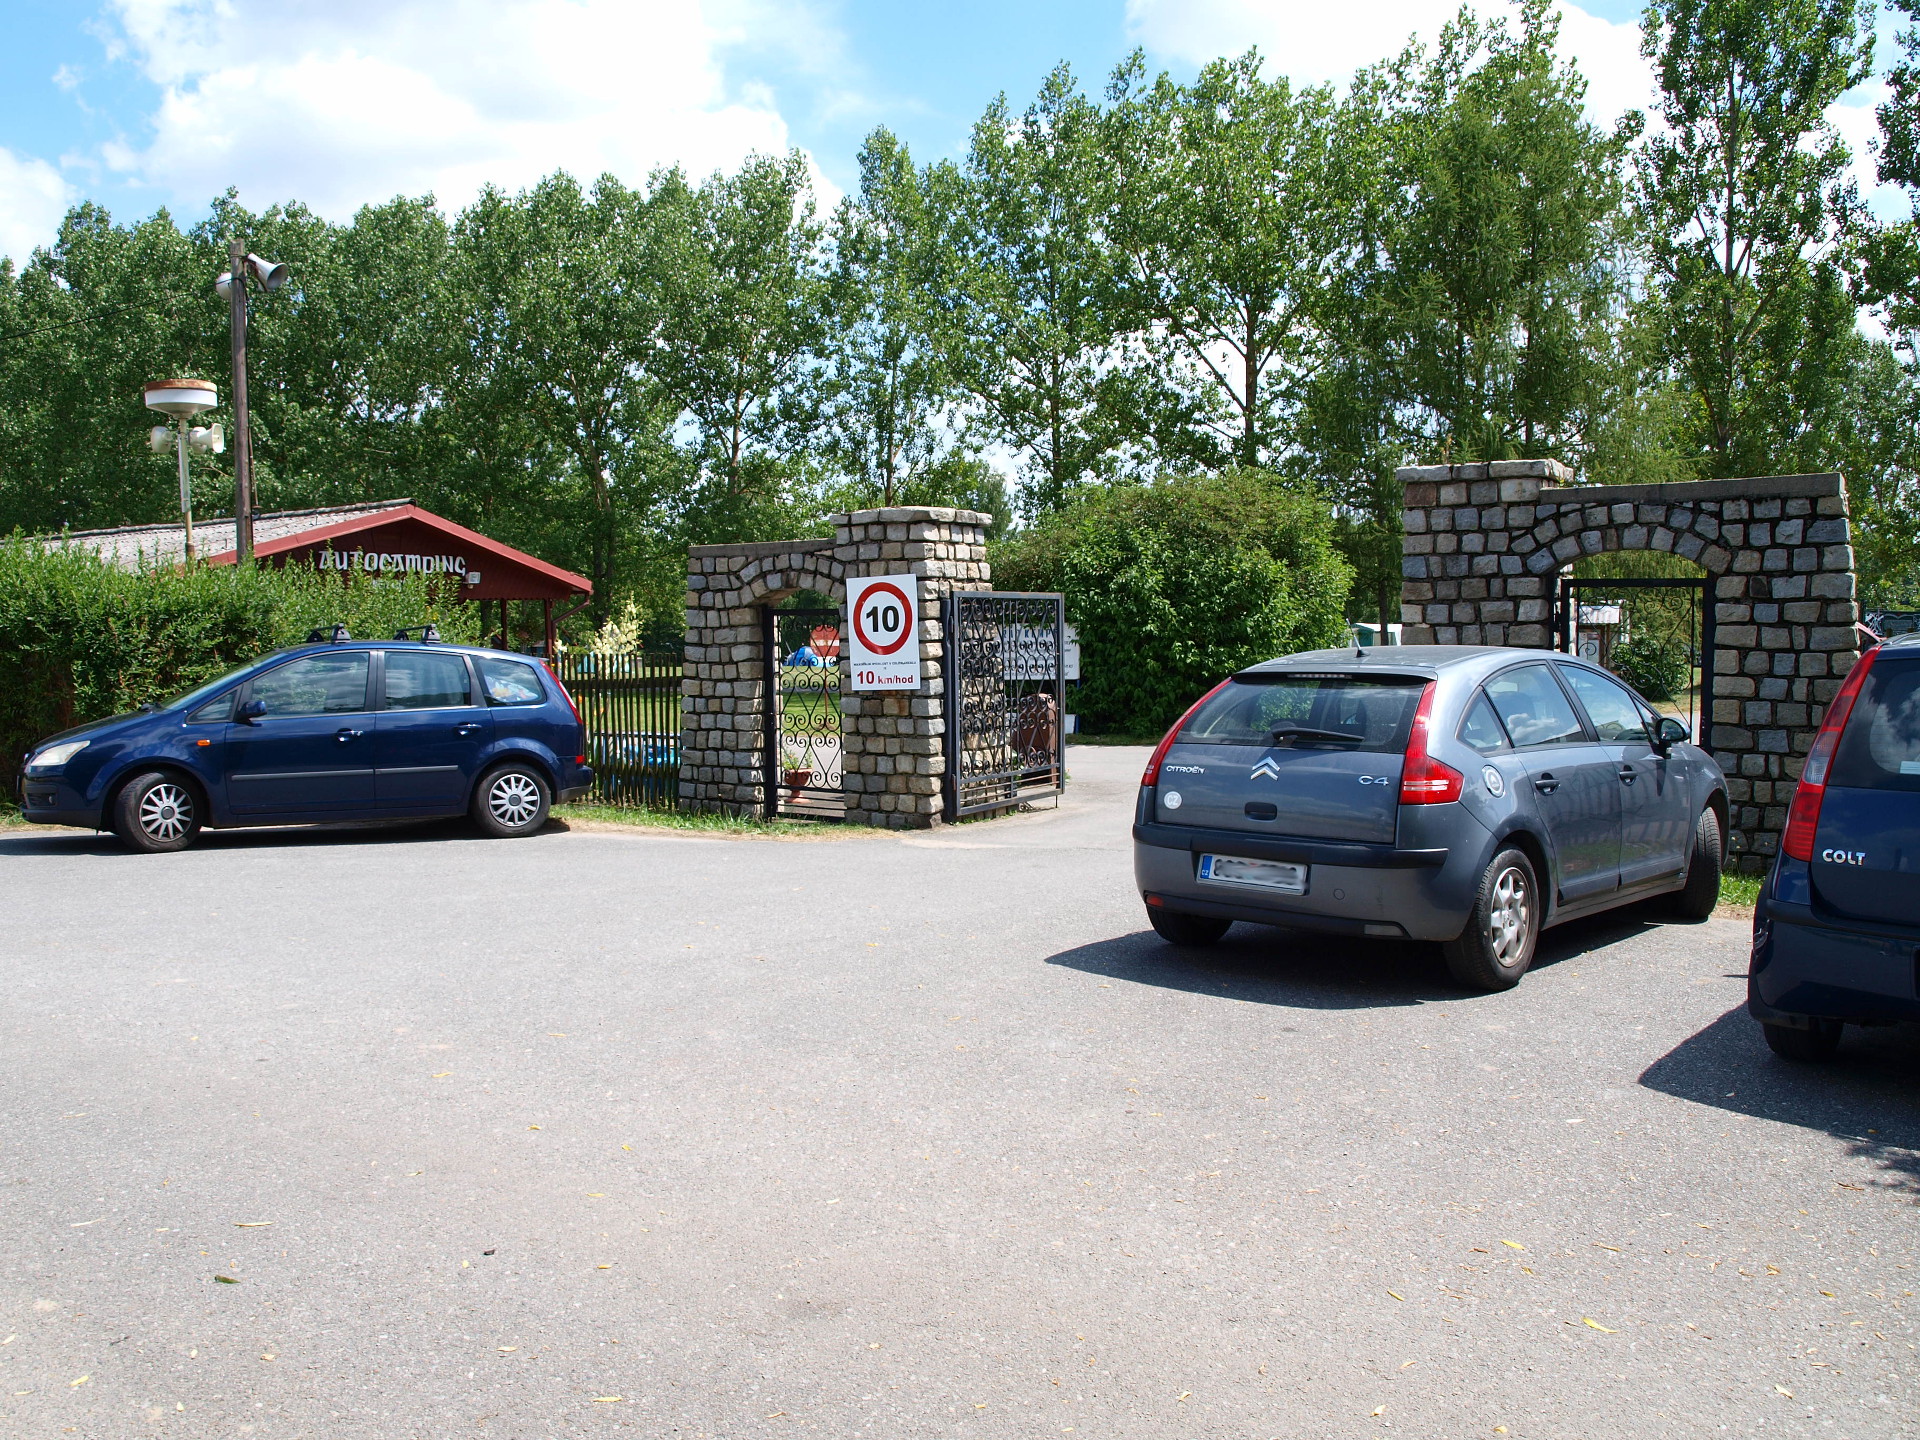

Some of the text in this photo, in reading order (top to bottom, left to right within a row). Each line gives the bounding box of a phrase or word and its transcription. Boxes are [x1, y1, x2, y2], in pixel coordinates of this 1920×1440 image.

[318, 551, 466, 576] AUTOCAMPING
[866, 605, 900, 633] 10
[857, 670, 914, 684] 10 km/hod
[1166, 765, 1205, 774] CITROËN
[1358, 775, 1390, 786] C4
[1167, 795, 1179, 806] CZ
[1822, 848, 1866, 866] COLT
